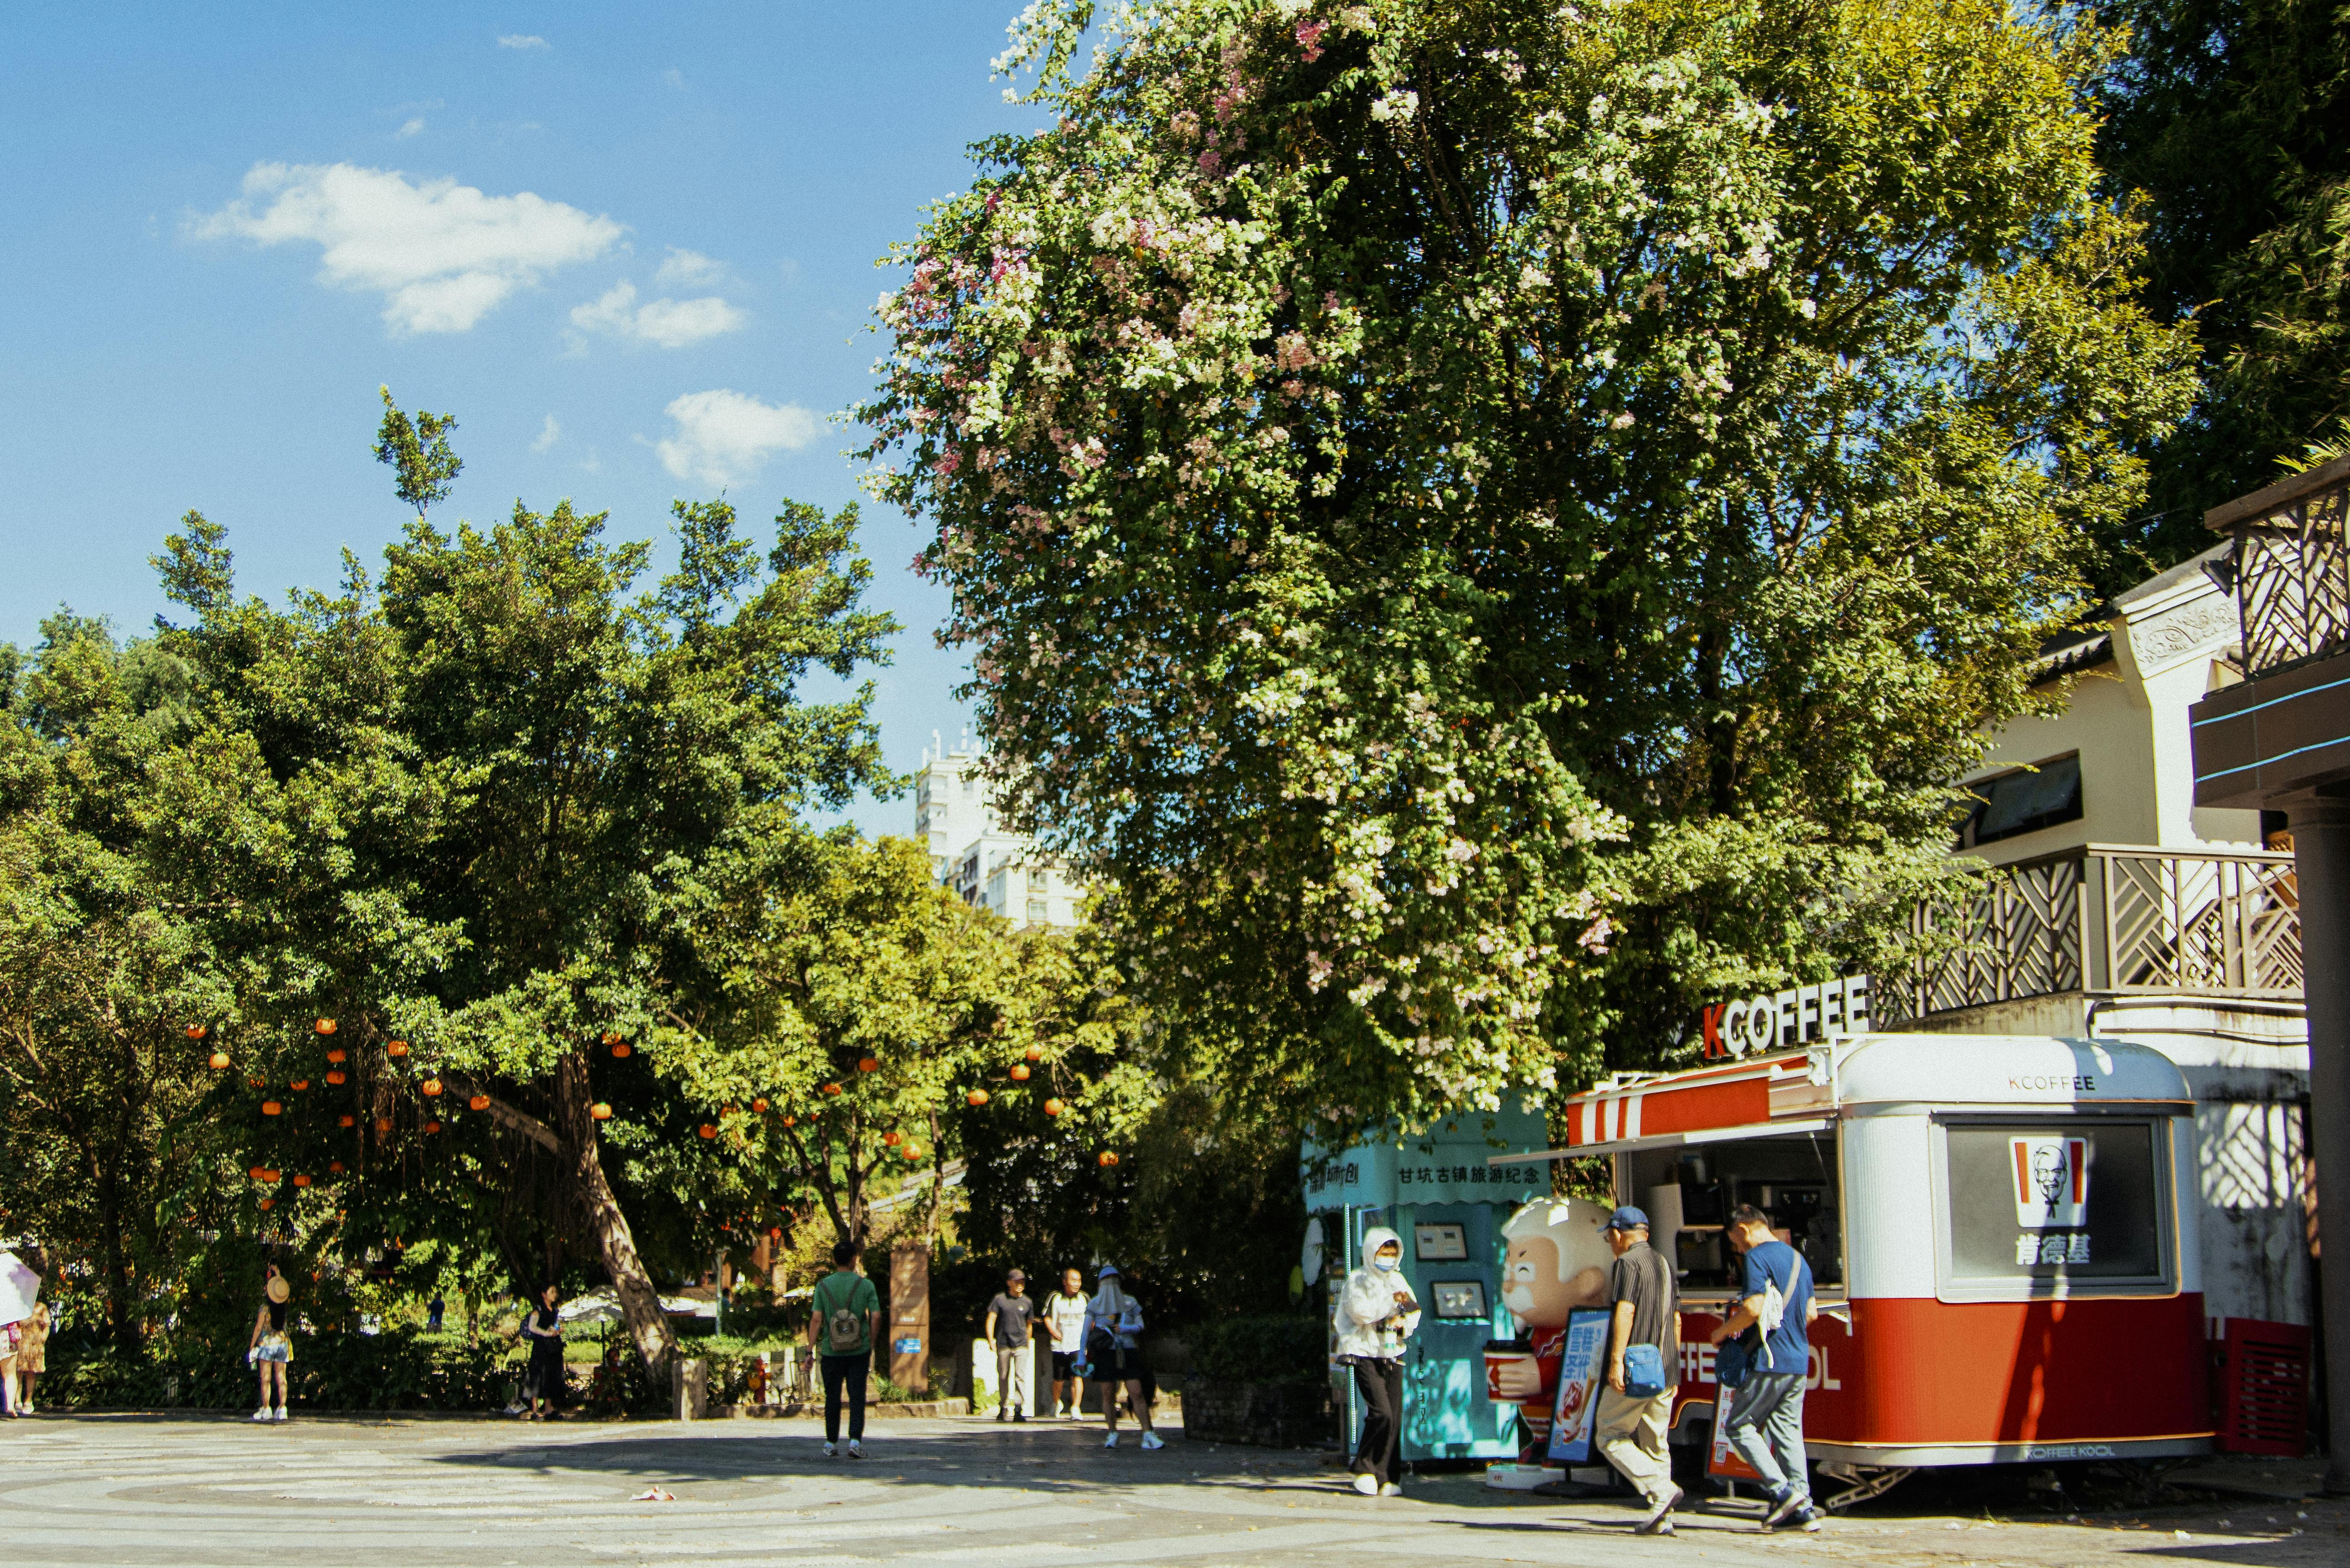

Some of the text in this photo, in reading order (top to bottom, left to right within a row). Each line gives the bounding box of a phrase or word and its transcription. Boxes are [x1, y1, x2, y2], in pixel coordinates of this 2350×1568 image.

[1703, 974, 1869, 1059] KCOFFEE
[2008, 1076, 2096, 1091] KCOFFEE
[1399, 1166, 1540, 1184] 甘坑古镇旅游纪念
[2015, 1232, 2091, 1265] 肯德基
[2079, 1446, 2115, 1457] KOOL
